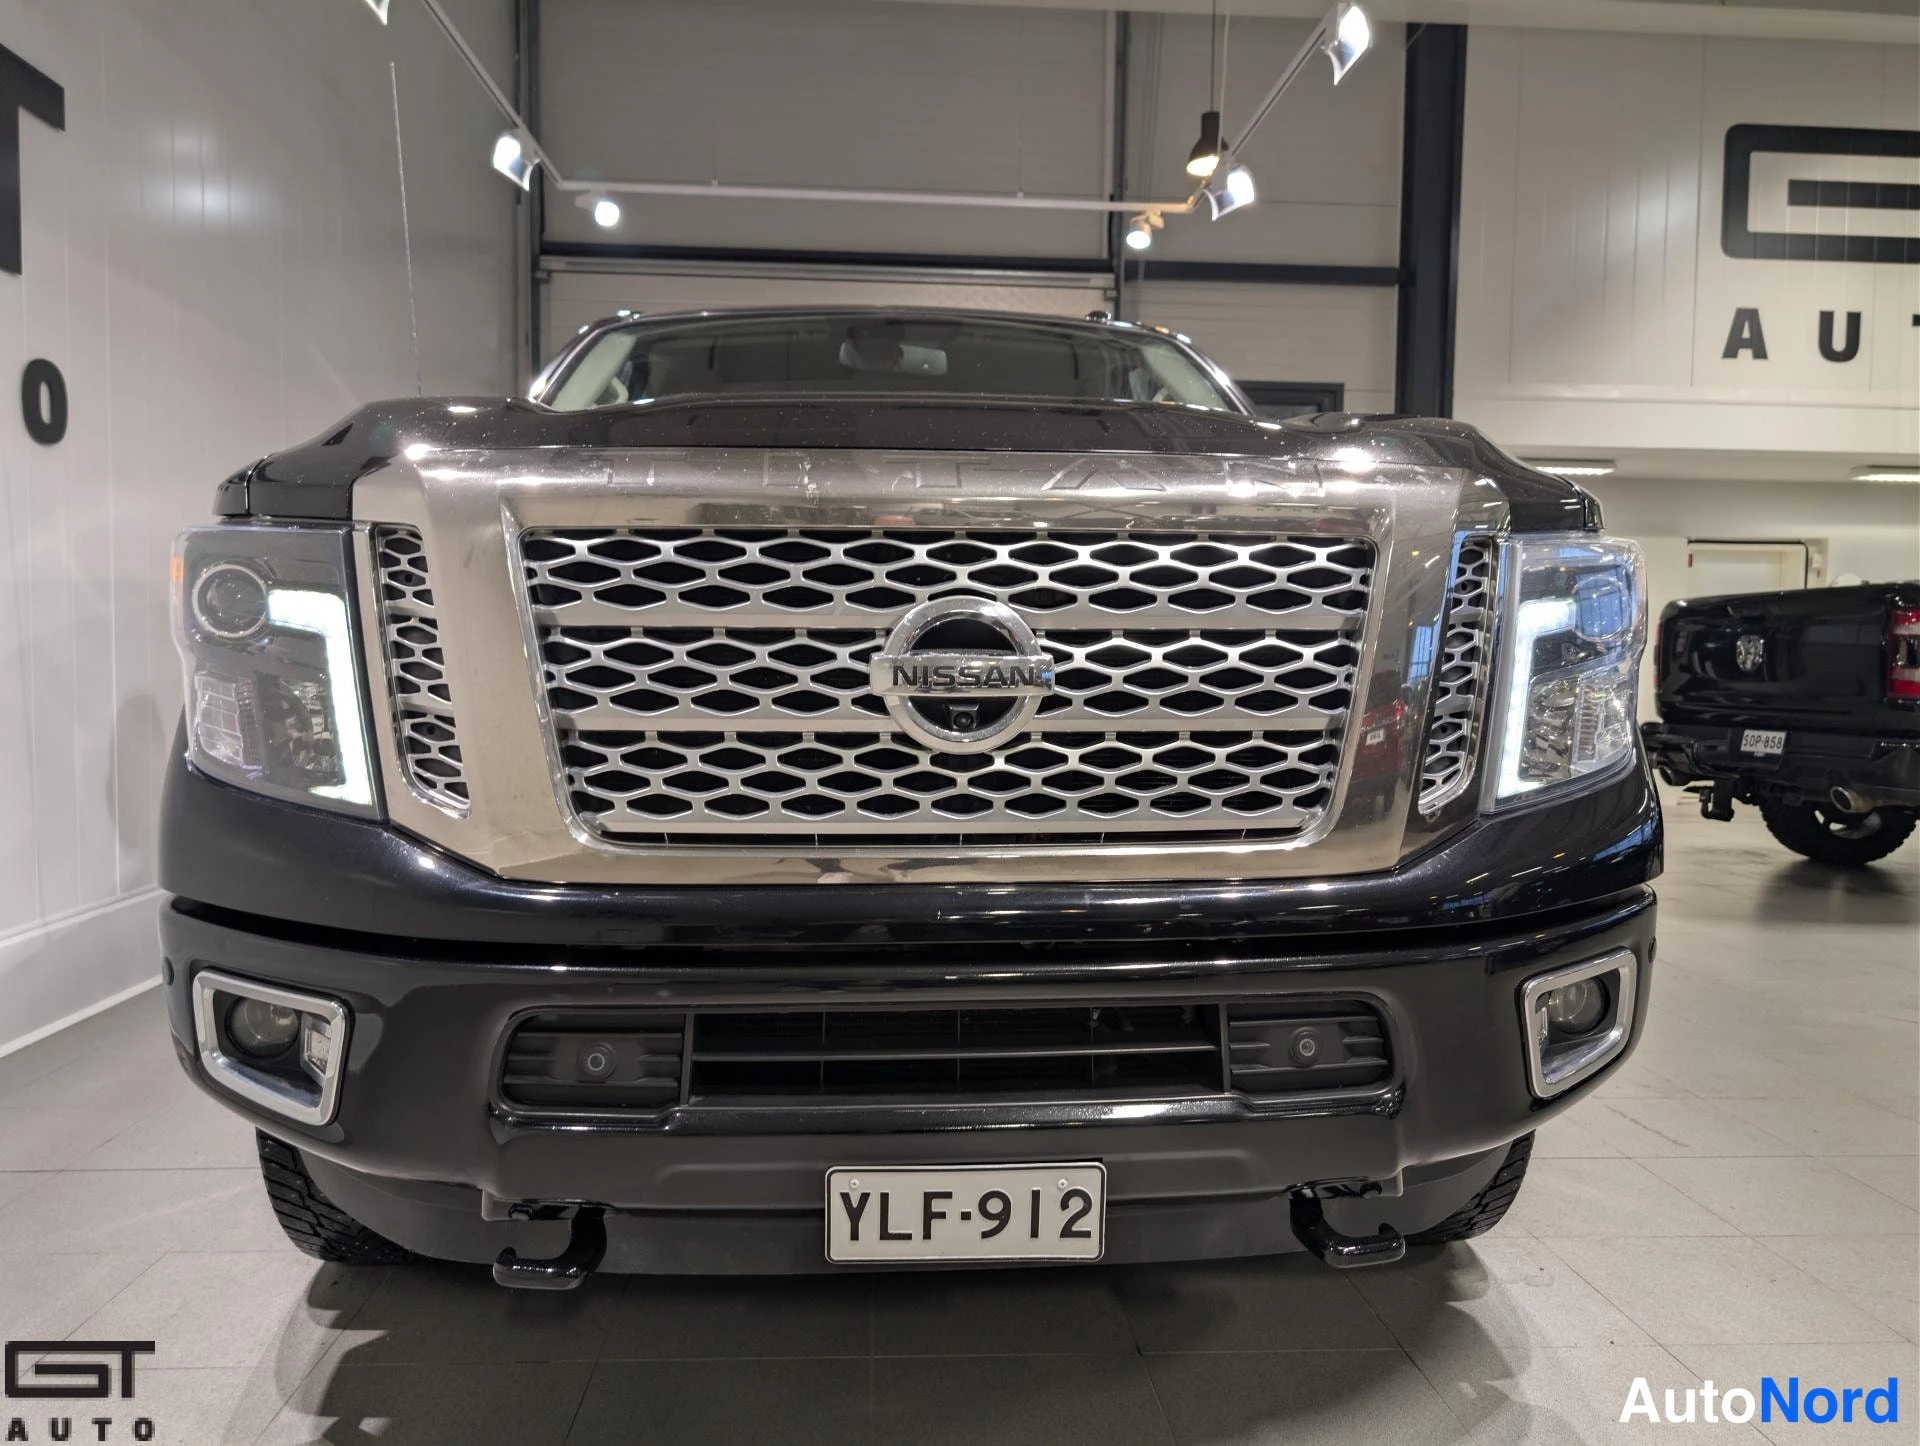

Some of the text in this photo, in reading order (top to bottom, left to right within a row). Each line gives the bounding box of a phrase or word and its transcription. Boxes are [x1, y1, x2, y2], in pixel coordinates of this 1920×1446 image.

[1721, 307, 1920, 363] AU
[892, 665, 1034, 688] NISSAN
[1743, 734, 1783, 749] SOP-858
[839, 1188, 1093, 1241] YLF-912
